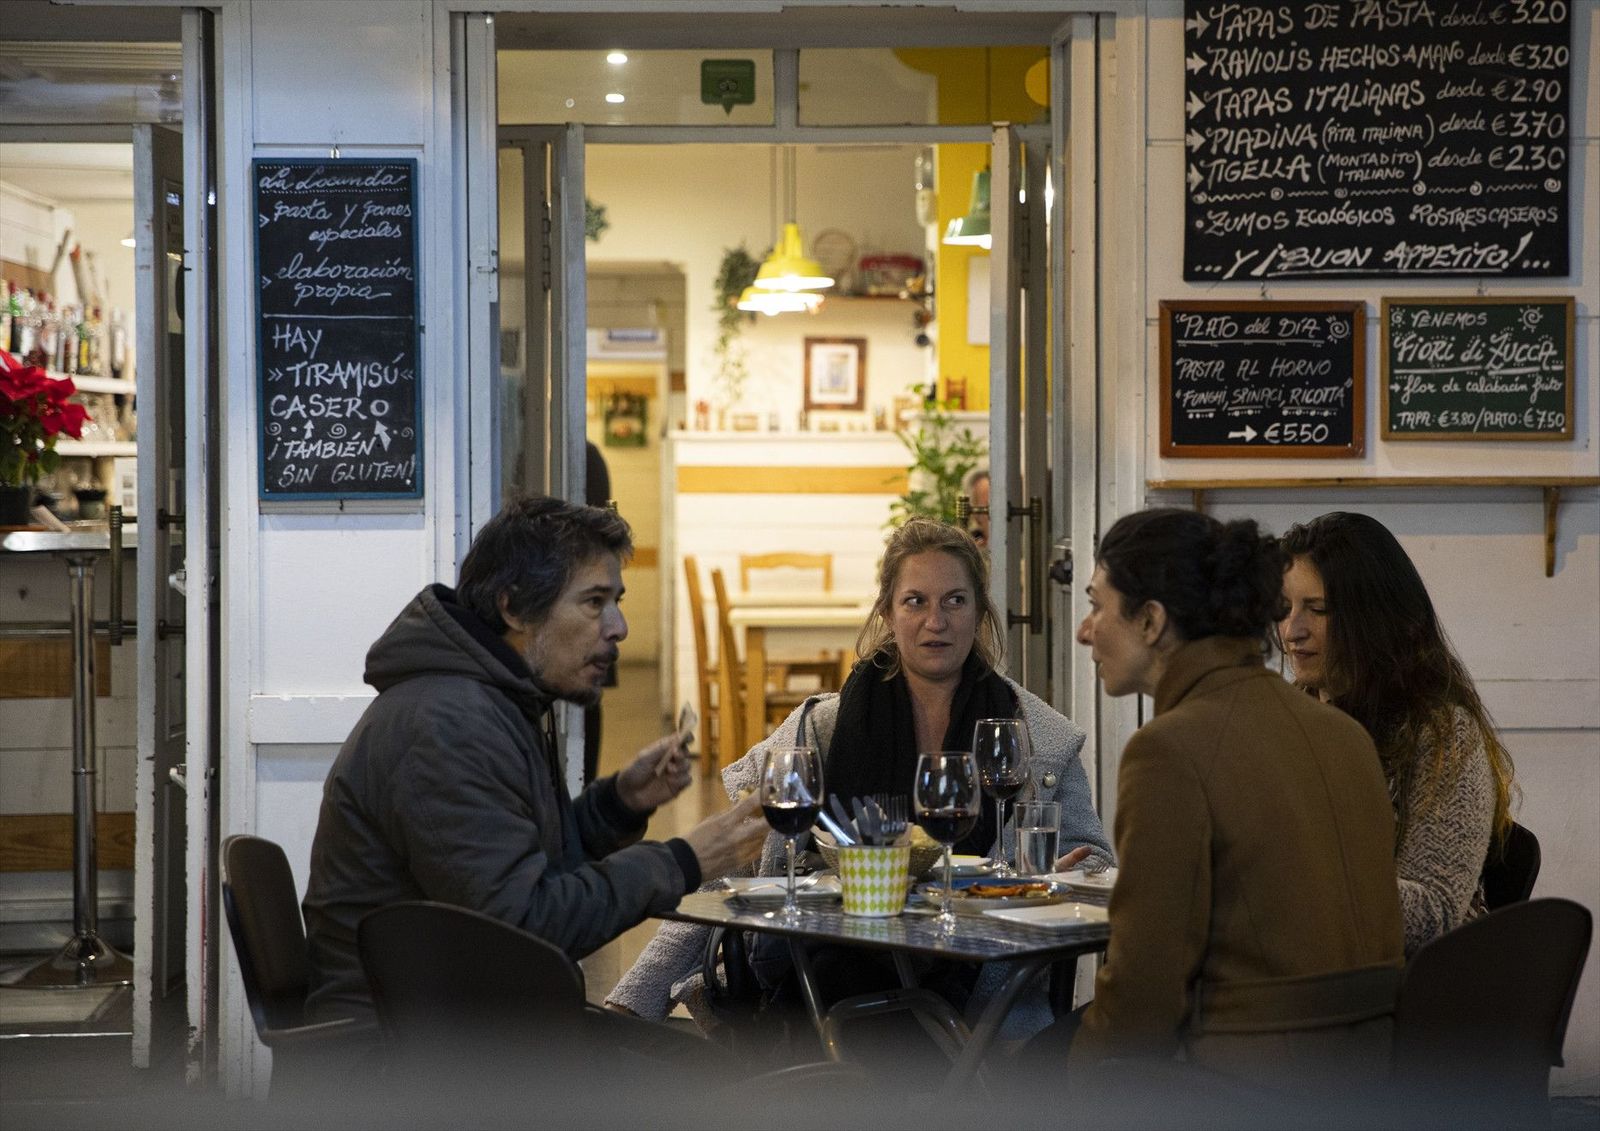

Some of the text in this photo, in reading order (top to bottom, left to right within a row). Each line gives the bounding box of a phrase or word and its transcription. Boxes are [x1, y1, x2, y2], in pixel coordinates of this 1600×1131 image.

[1209, 3, 1294, 42] TAPAS
[1304, 4, 1340, 30] DE
[1350, 0, 1435, 31] PASTA
[1440, 2, 1488, 27] desde
[1319, 43, 1400, 73] HECHOS
[1467, 42, 1506, 66] desde
[1204, 87, 1293, 122] TAPAS
[1436, 78, 1485, 99] desde
[1439, 110, 1485, 134] desde
[259, 167, 295, 190] La
[1200, 154, 1312, 190] TIGELLA
[1427, 147, 1483, 167] desde
[274, 199, 333, 222] pasta
[361, 201, 412, 223] panes
[1204, 210, 1289, 236] ZUMOS
[1296, 200, 1396, 228] ECOLÓGICOS
[309, 221, 402, 252] especiales
[276, 252, 413, 281] elaboración
[294, 282, 392, 307] propia
[1244, 317, 1270, 334] del
[1411, 309, 1487, 330] TENEMOS
[272, 323, 322, 359] HAY
[1460, 339, 1486, 362] di
[1485, 331, 1558, 370] ZUCCA
[1236, 359, 1259, 381] AL
[1269, 357, 1331, 379] HORNO
[1404, 375, 1562, 404] flor de calabacín frito
[270, 394, 390, 420] CASERO
[278, 453, 416, 488] SIN GLUTEN!
